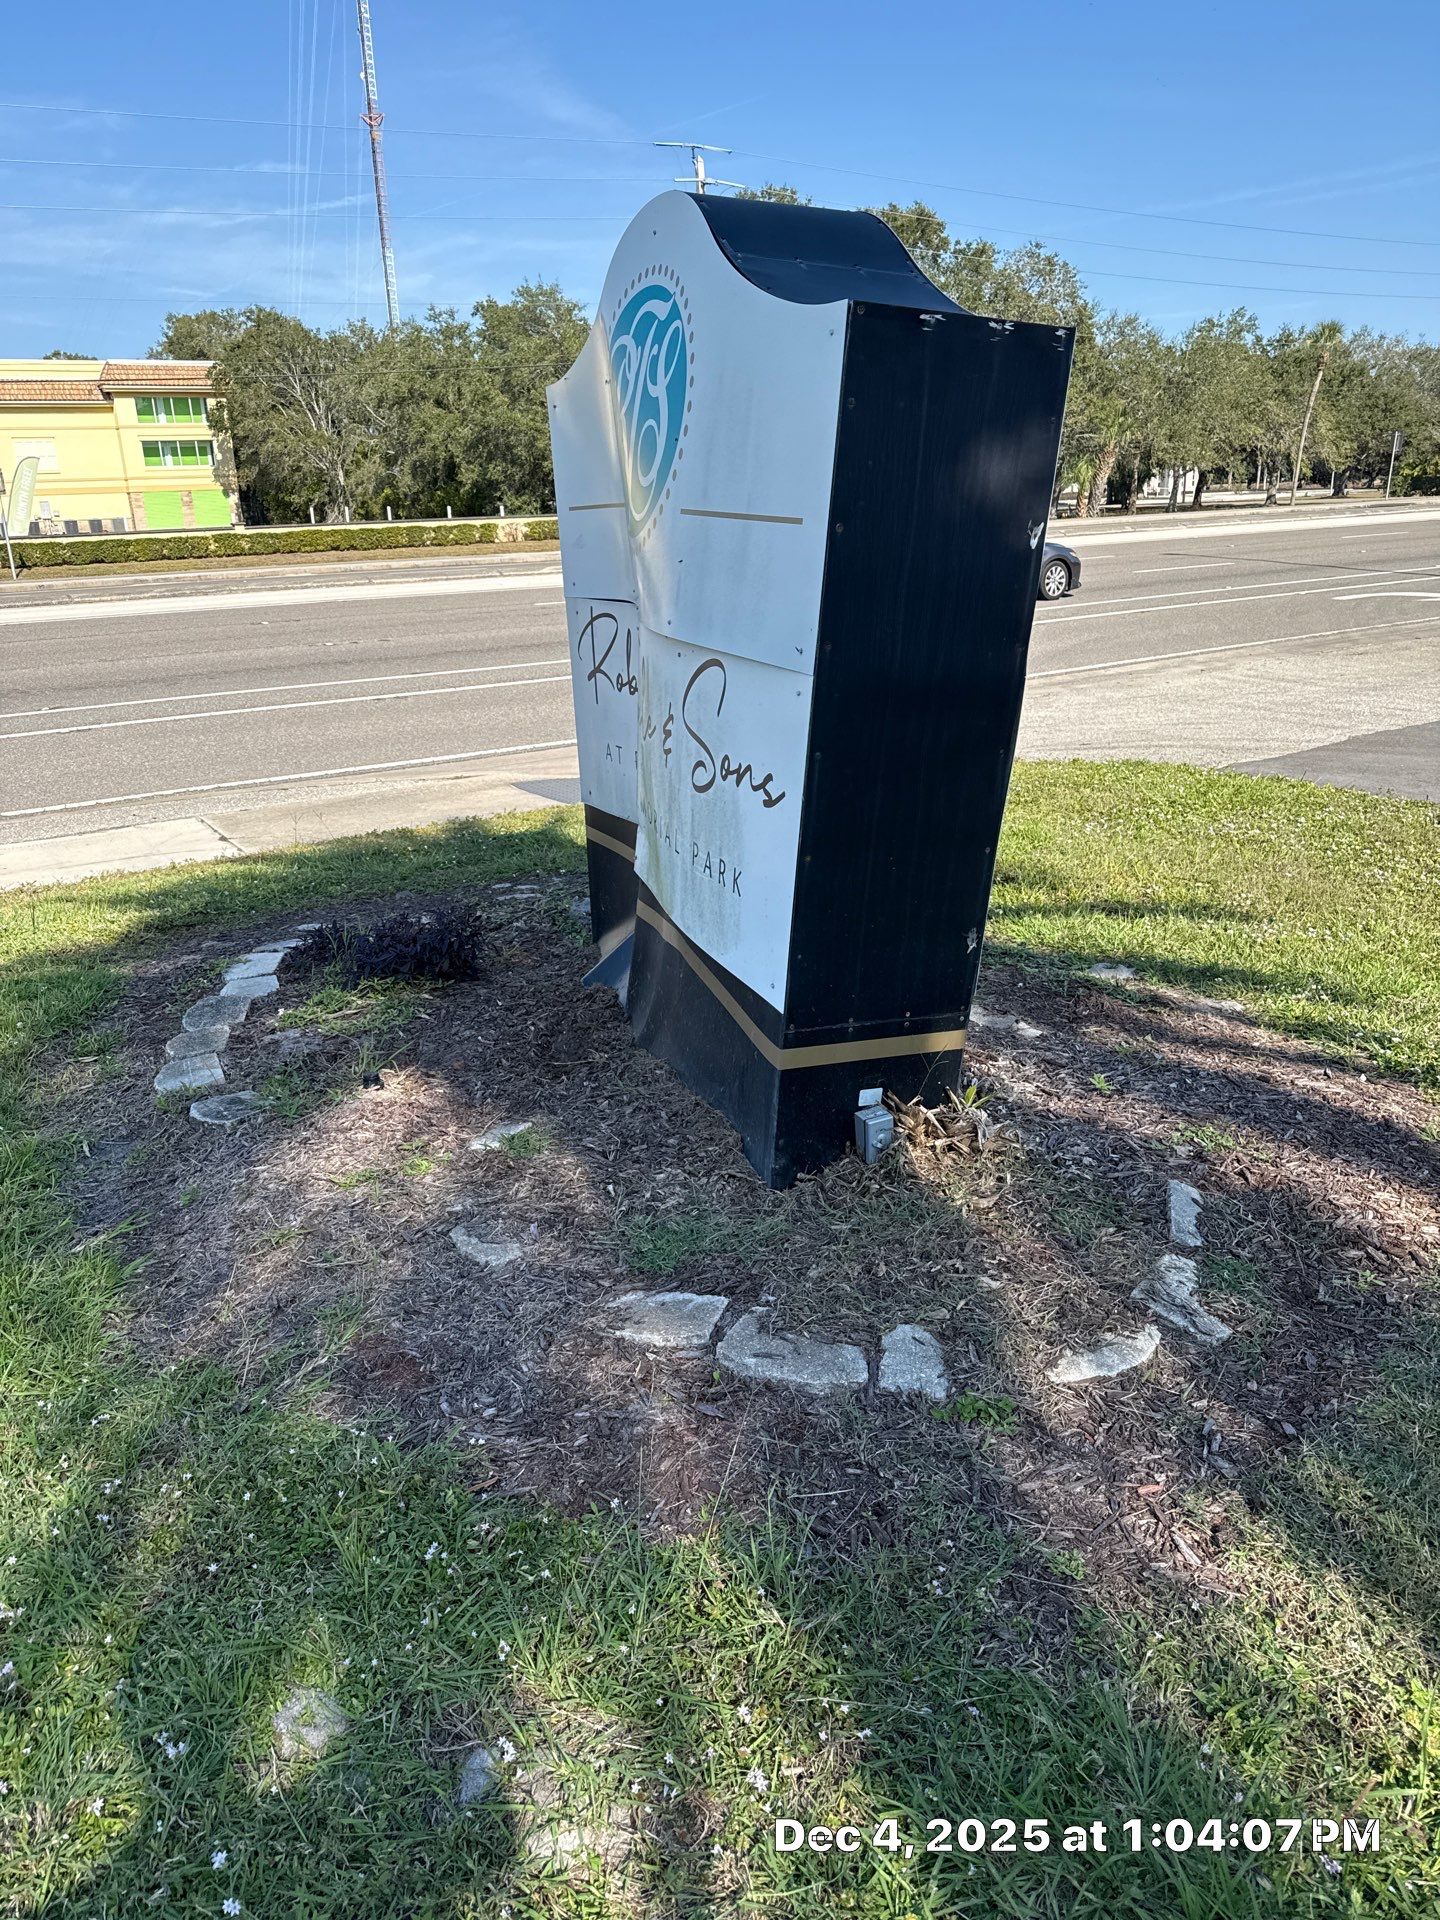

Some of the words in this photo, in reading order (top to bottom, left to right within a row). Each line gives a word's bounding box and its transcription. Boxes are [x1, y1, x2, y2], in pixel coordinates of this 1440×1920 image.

[577, 605, 639, 705] Rob
[682, 657, 786, 809] Sons
[605, 742, 623, 765] AT
[692, 840, 742, 898] PARK
